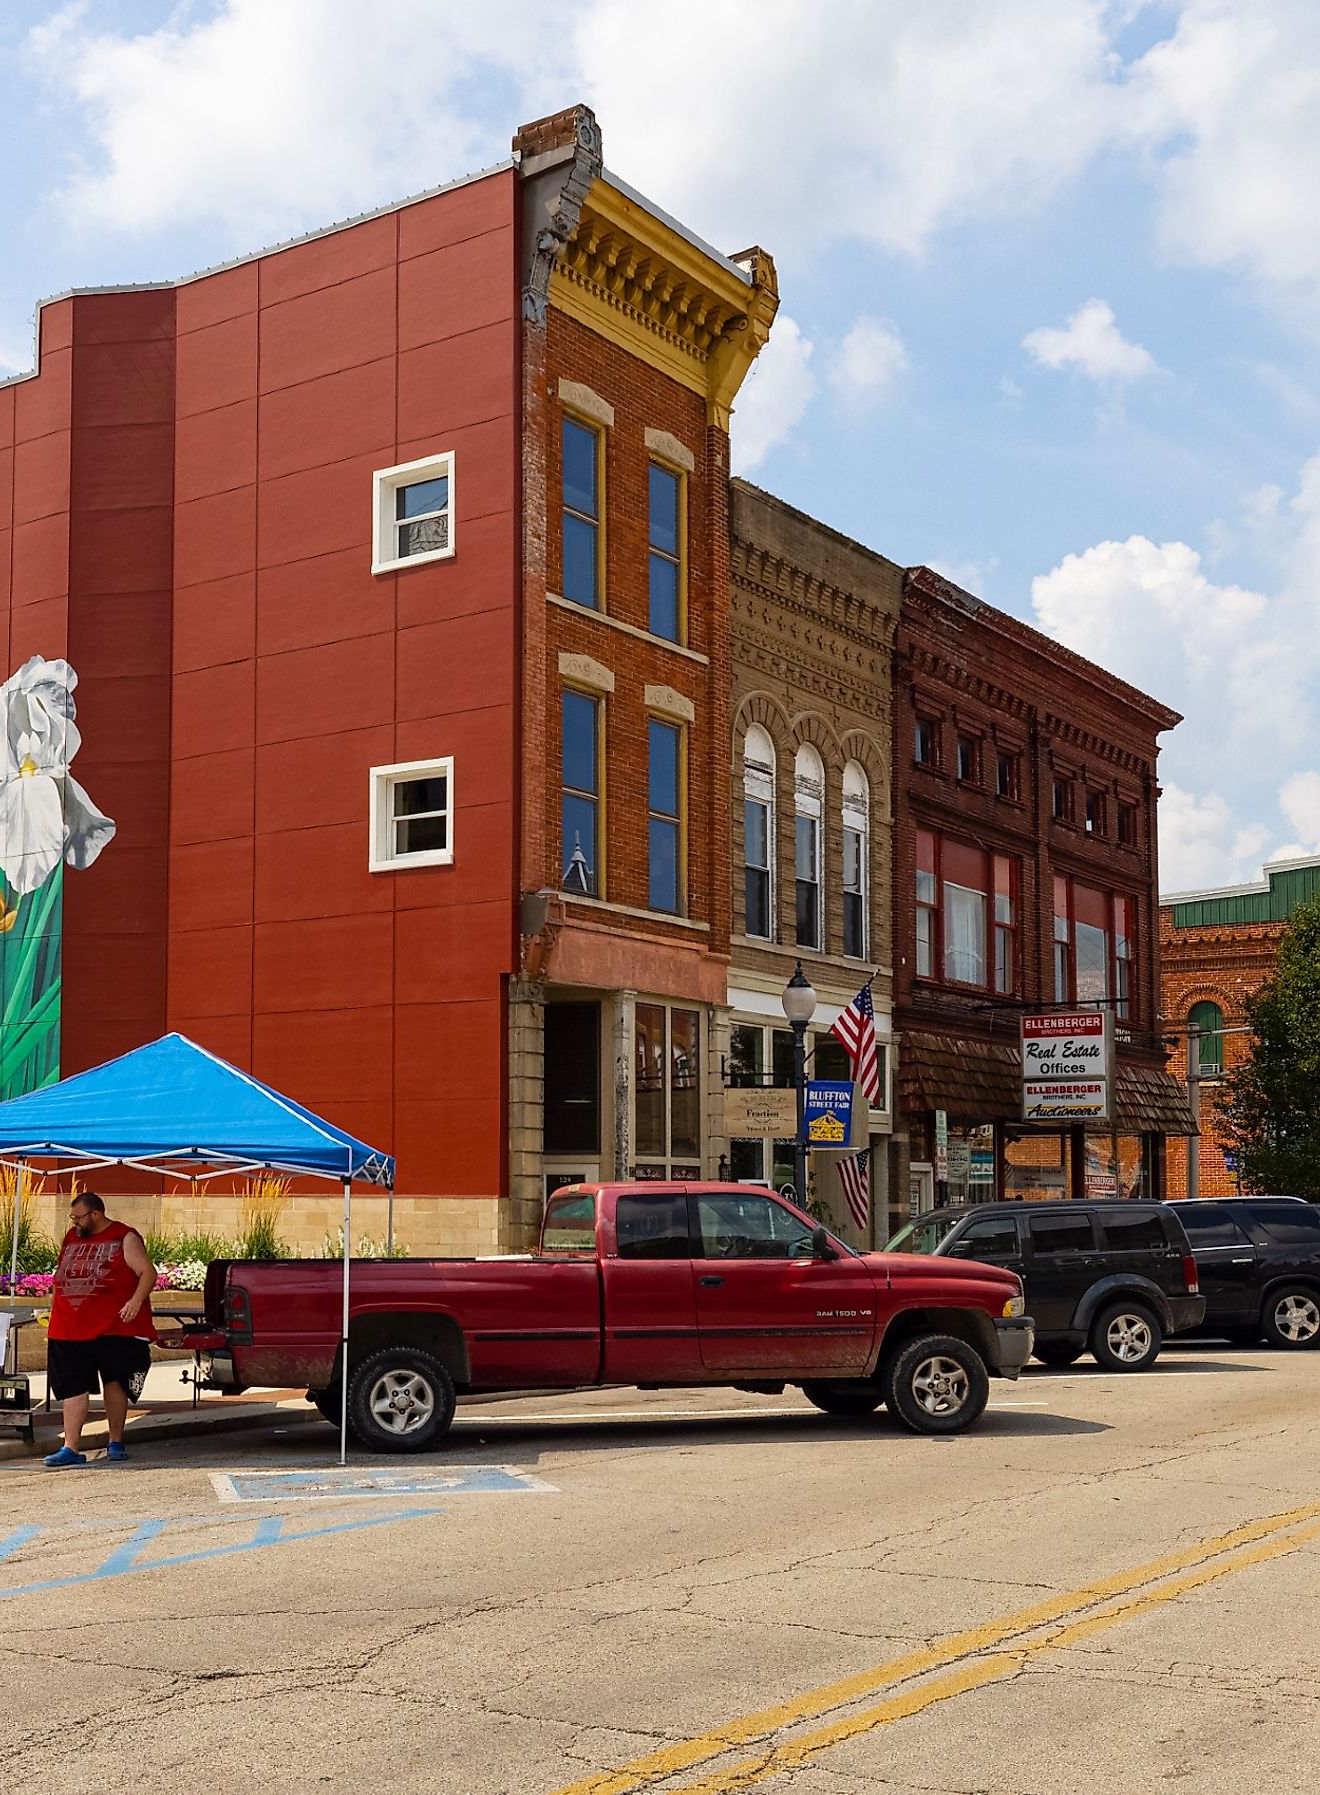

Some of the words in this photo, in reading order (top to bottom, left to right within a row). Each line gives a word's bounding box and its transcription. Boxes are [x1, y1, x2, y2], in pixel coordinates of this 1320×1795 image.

[1025, 1016, 1101, 1029] ELLENBERGER
[1026, 1042, 1057, 1059] Real
[1062, 1040, 1101, 1058] Estate
[1040, 1063, 1086, 1074] Offices
[1026, 1085, 1101, 1094] ELLENBERGER
[809, 1090, 851, 1101] BLUFFTON
[834, 1101, 850, 1109] FAIR
[1027, 1104, 1102, 1117] Auctioneers
